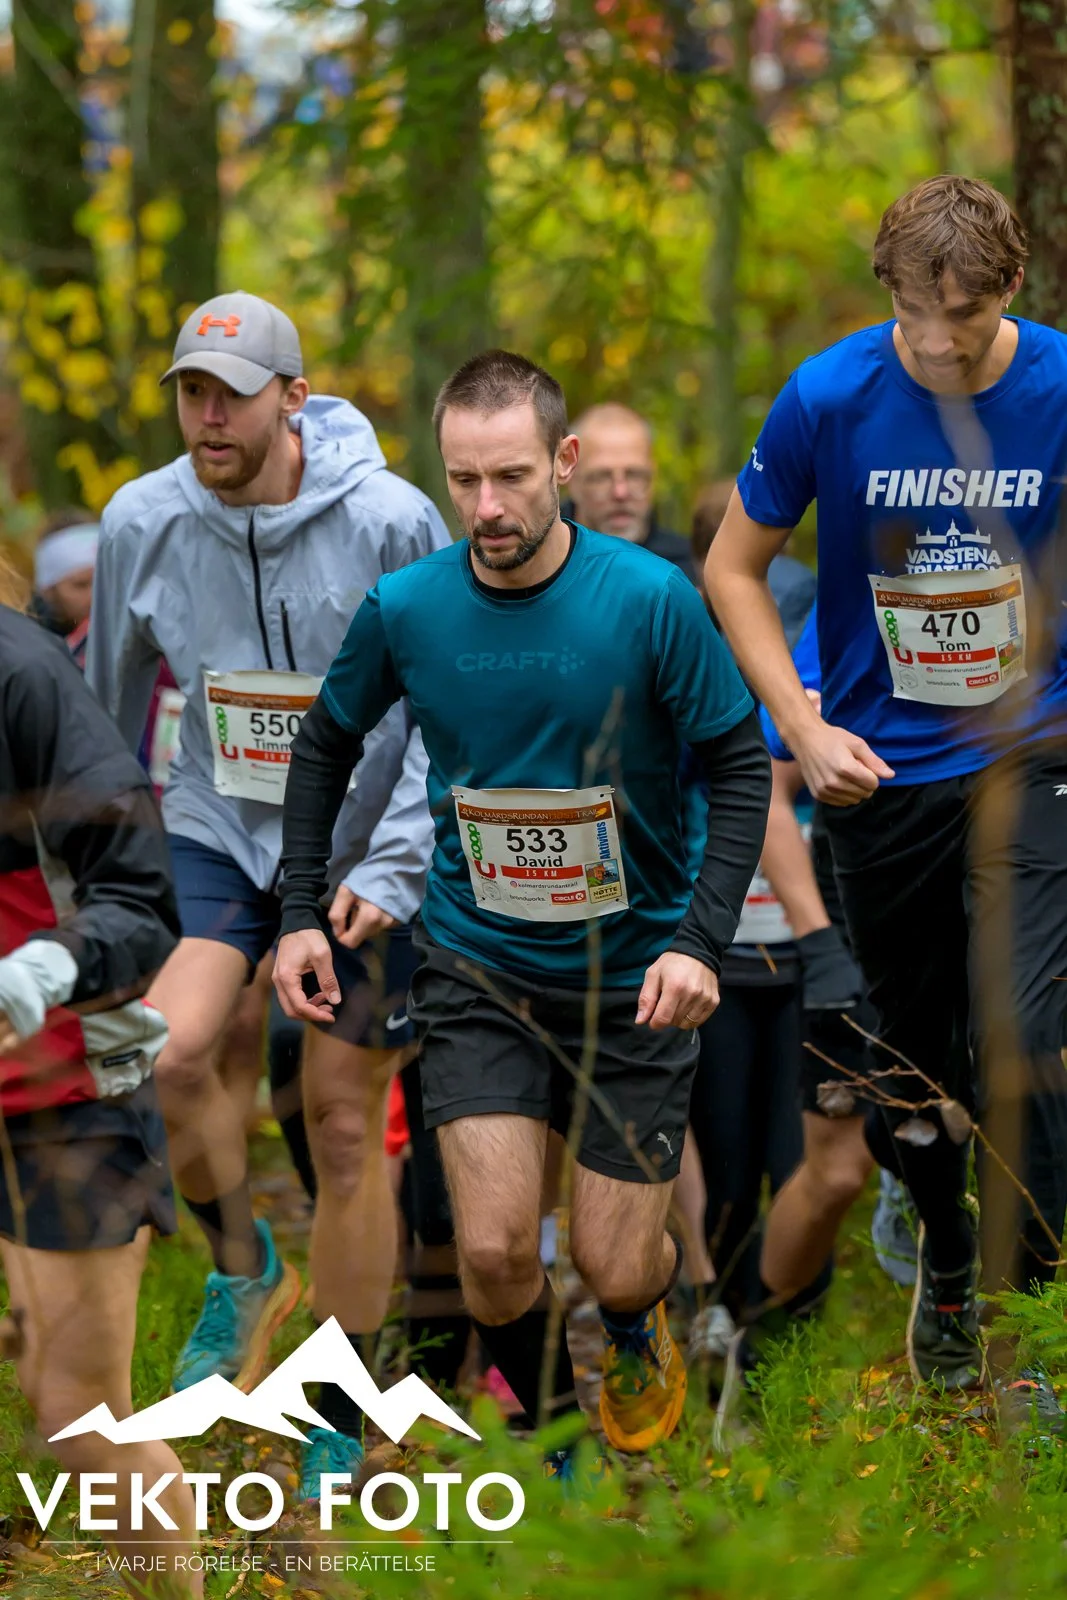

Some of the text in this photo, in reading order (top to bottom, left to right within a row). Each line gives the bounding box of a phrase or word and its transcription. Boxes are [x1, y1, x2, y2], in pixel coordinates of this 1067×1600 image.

[865, 468, 1043, 507] FINISHER
[906, 546, 1002, 565] VADSTENA
[905, 563, 996, 575] TRIATHLO
[921, 611, 981, 638] 470
[936, 641, 971, 652] Tom
[455, 651, 556, 672] CRAFT
[250, 712, 301, 737] 550
[467, 823, 483, 861] coop
[506, 828, 568, 853] 533
[596, 821, 611, 860] Aktivitus
[516, 855, 563, 867] David
